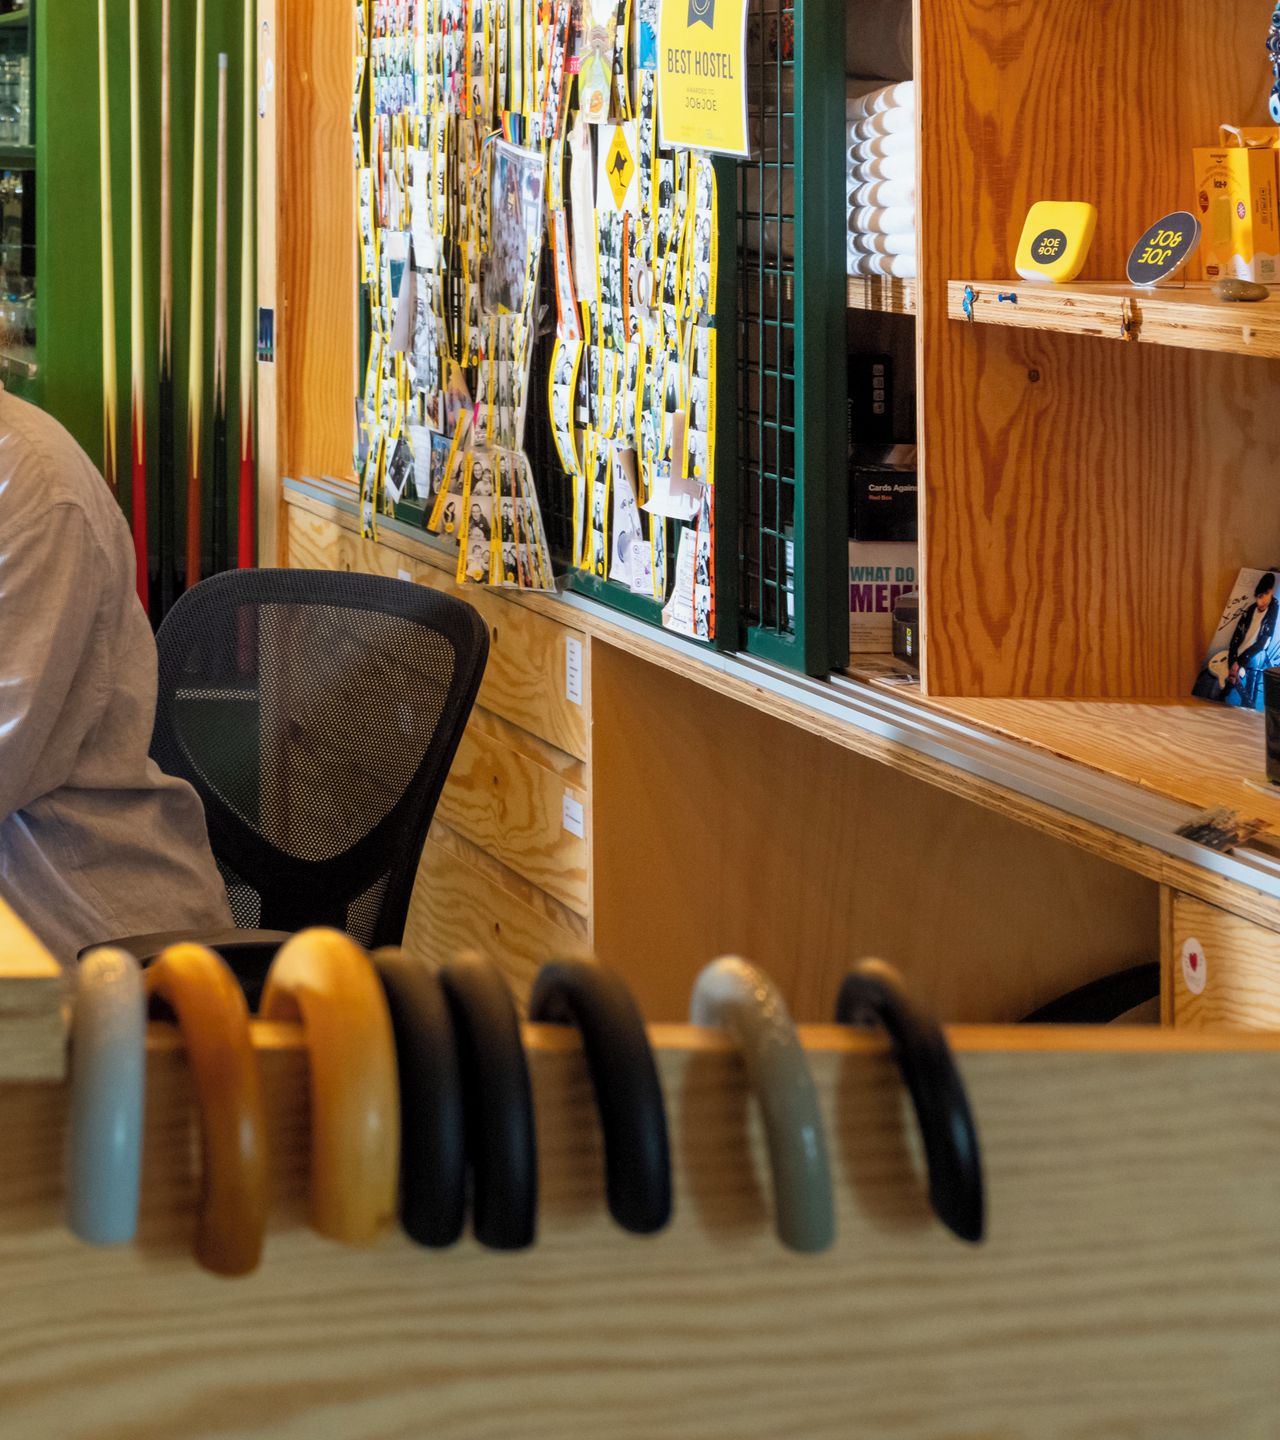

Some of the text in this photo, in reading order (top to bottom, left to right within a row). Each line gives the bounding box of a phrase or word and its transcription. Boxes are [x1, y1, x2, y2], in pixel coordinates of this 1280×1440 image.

[668, 48, 734, 80] BEST HOSTEL
[685, 97, 718, 111] JO&JOE
[1040, 237, 1061, 247] JOE
[850, 566, 915, 582] WHAT DO
